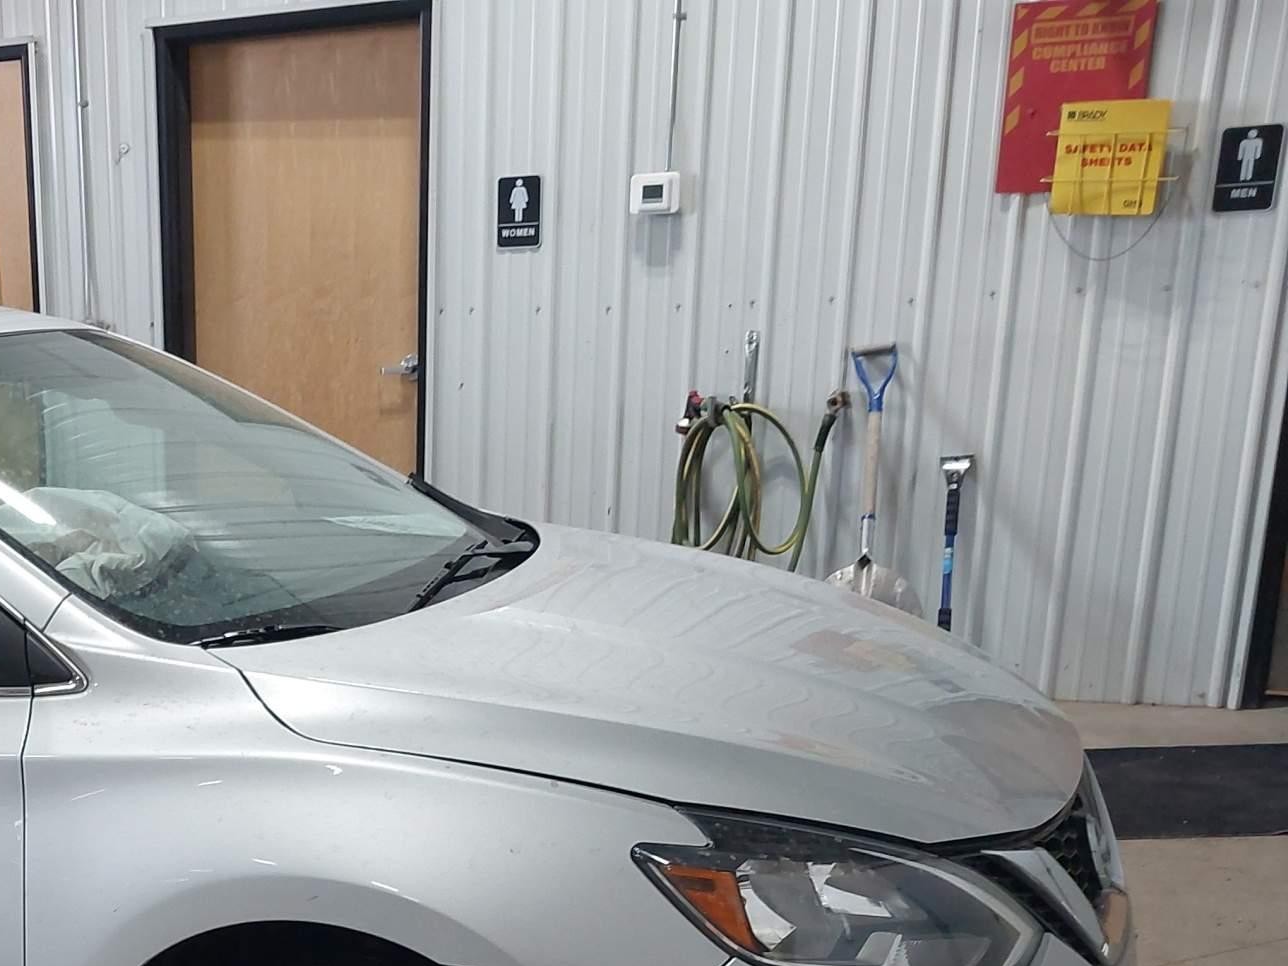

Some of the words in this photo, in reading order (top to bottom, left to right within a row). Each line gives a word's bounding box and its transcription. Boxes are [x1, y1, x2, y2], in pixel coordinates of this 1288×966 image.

[1032, 40, 1128, 60] COMPLIANCE
[1050, 57, 1107, 73] CENTER
[1230, 187, 1258, 199] MEN
[501, 227, 535, 238] WOMEN
